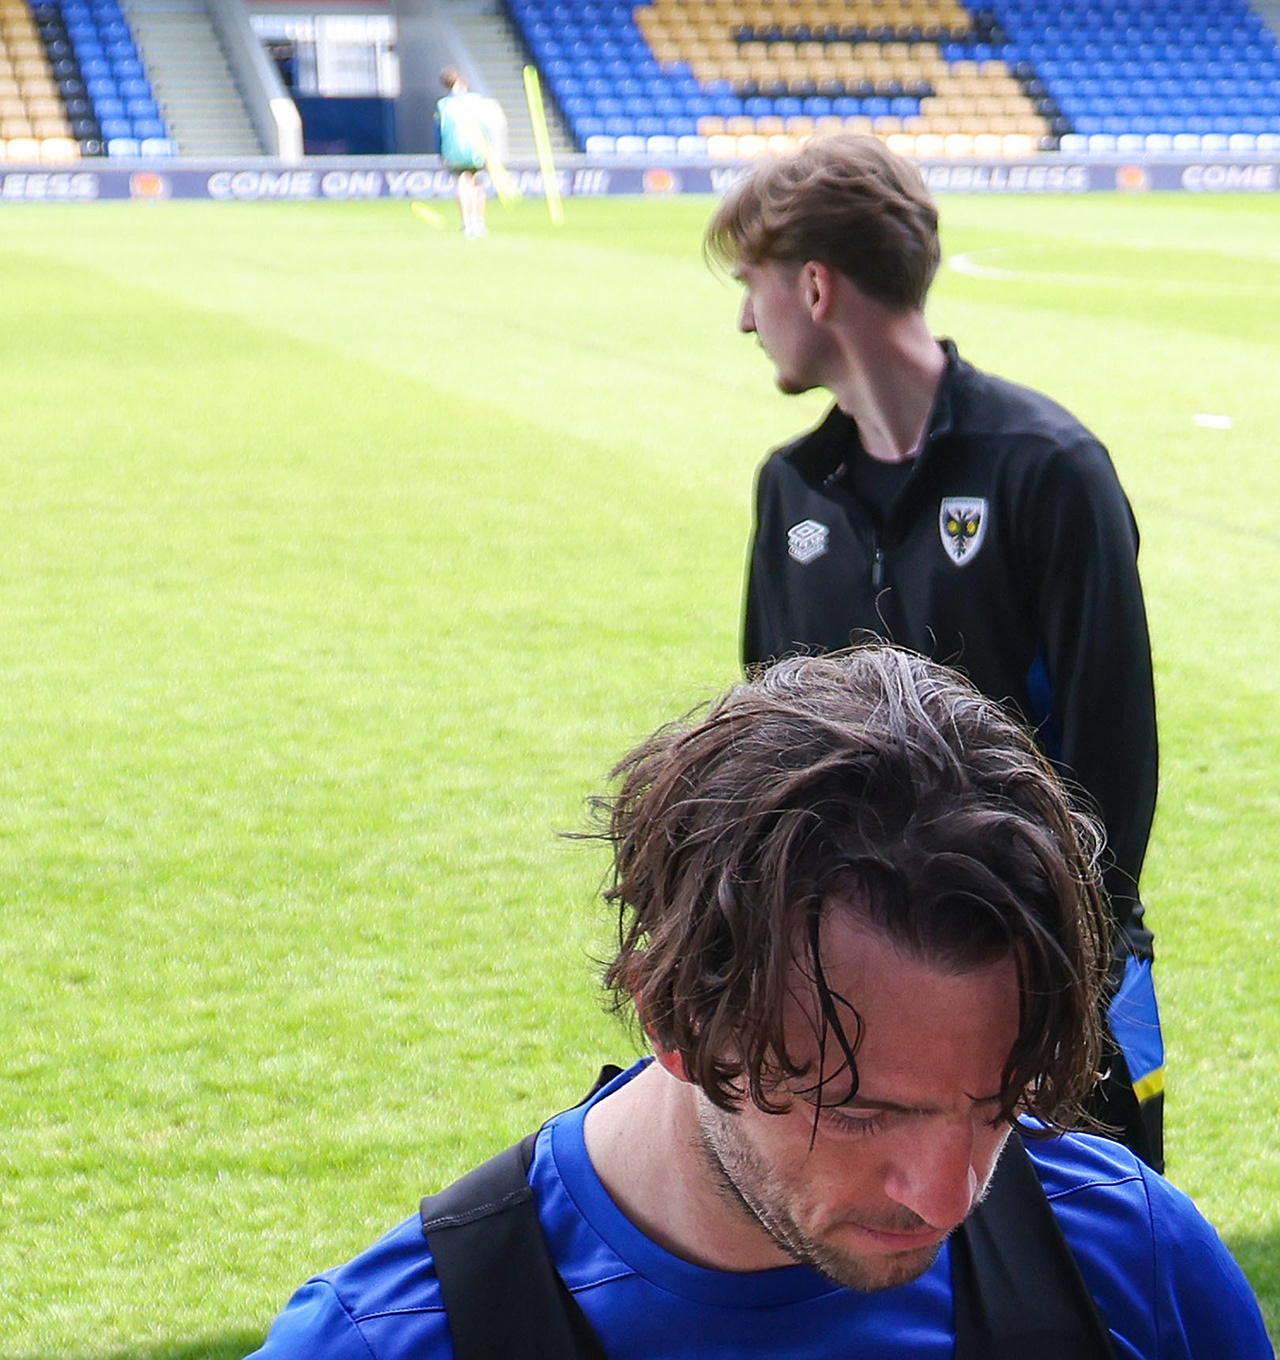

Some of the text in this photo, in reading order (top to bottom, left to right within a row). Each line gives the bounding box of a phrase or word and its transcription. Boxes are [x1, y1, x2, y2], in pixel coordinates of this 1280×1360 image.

[207, 172, 319, 199] COME
[321, 171, 383, 198] ON
[385, 171, 458, 198] YOU
[1181, 164, 1276, 190] COME
